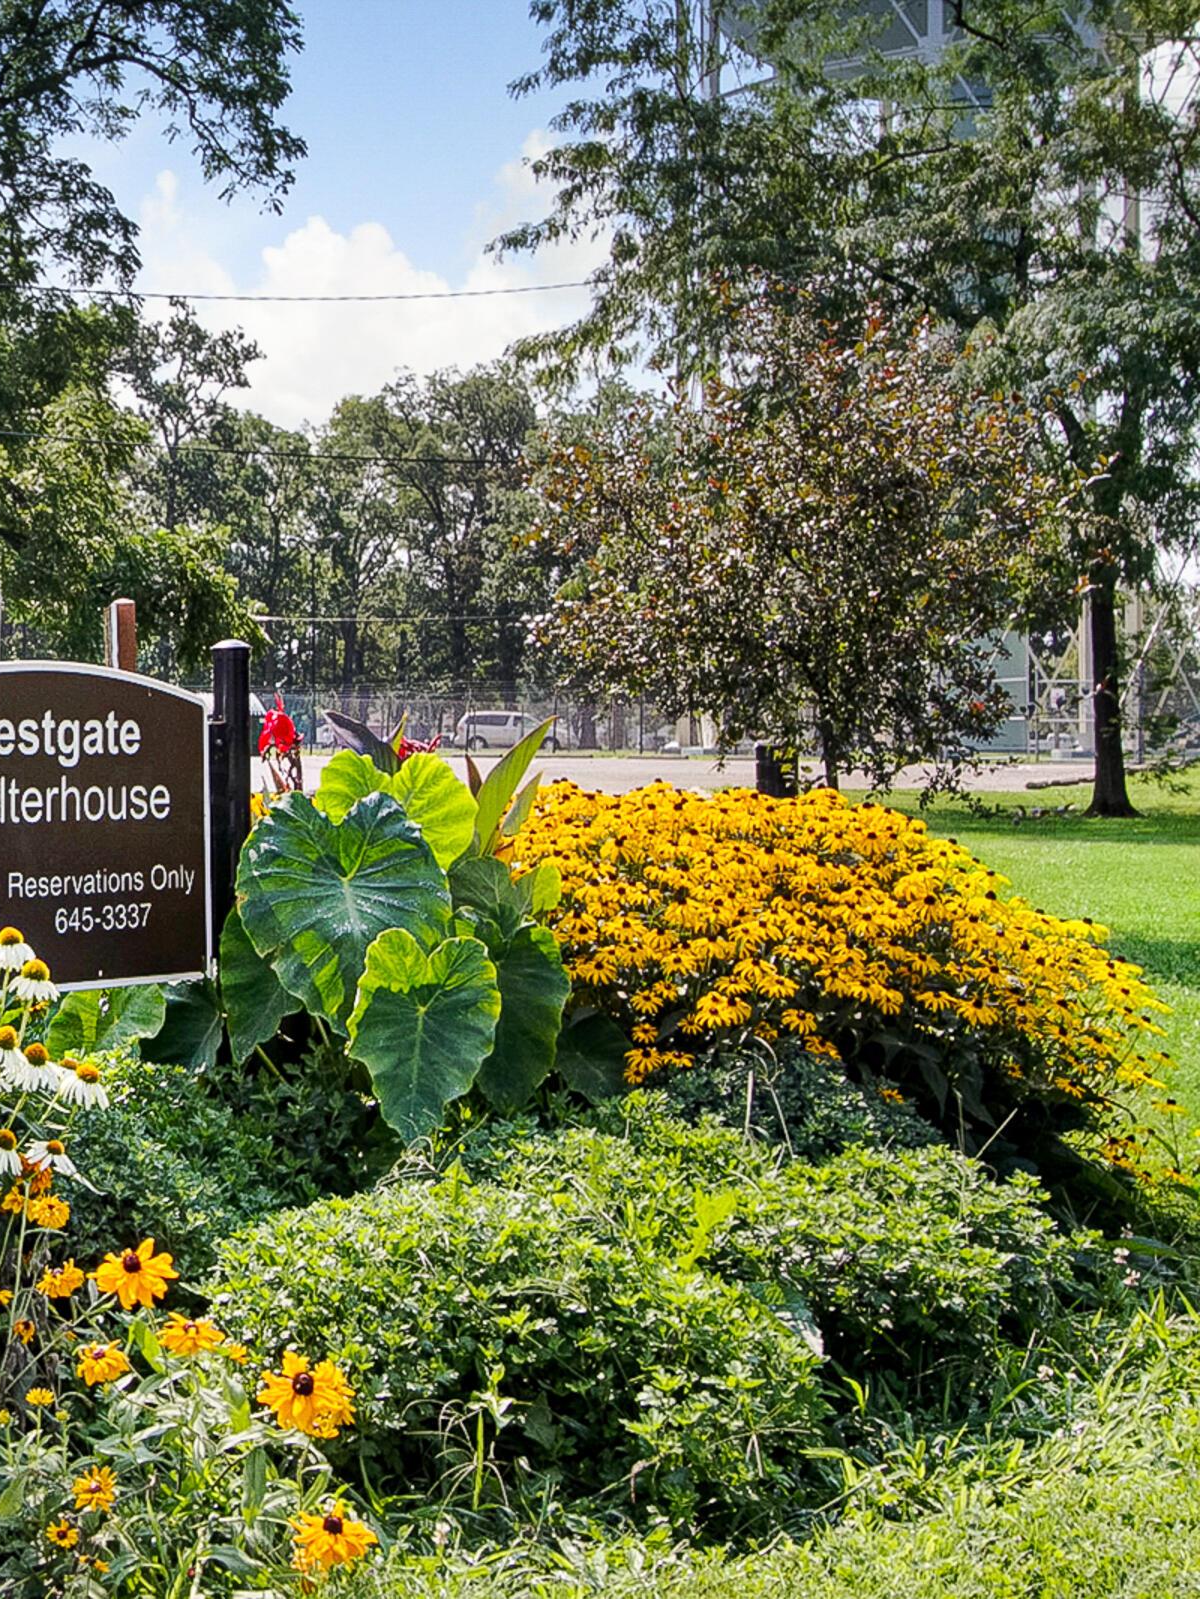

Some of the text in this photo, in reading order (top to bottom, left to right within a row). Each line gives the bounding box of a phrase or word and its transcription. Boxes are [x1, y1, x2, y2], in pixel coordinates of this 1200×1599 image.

[9, 864, 194, 898] Reservations Only
[55, 903, 151, 933] 645-3337
